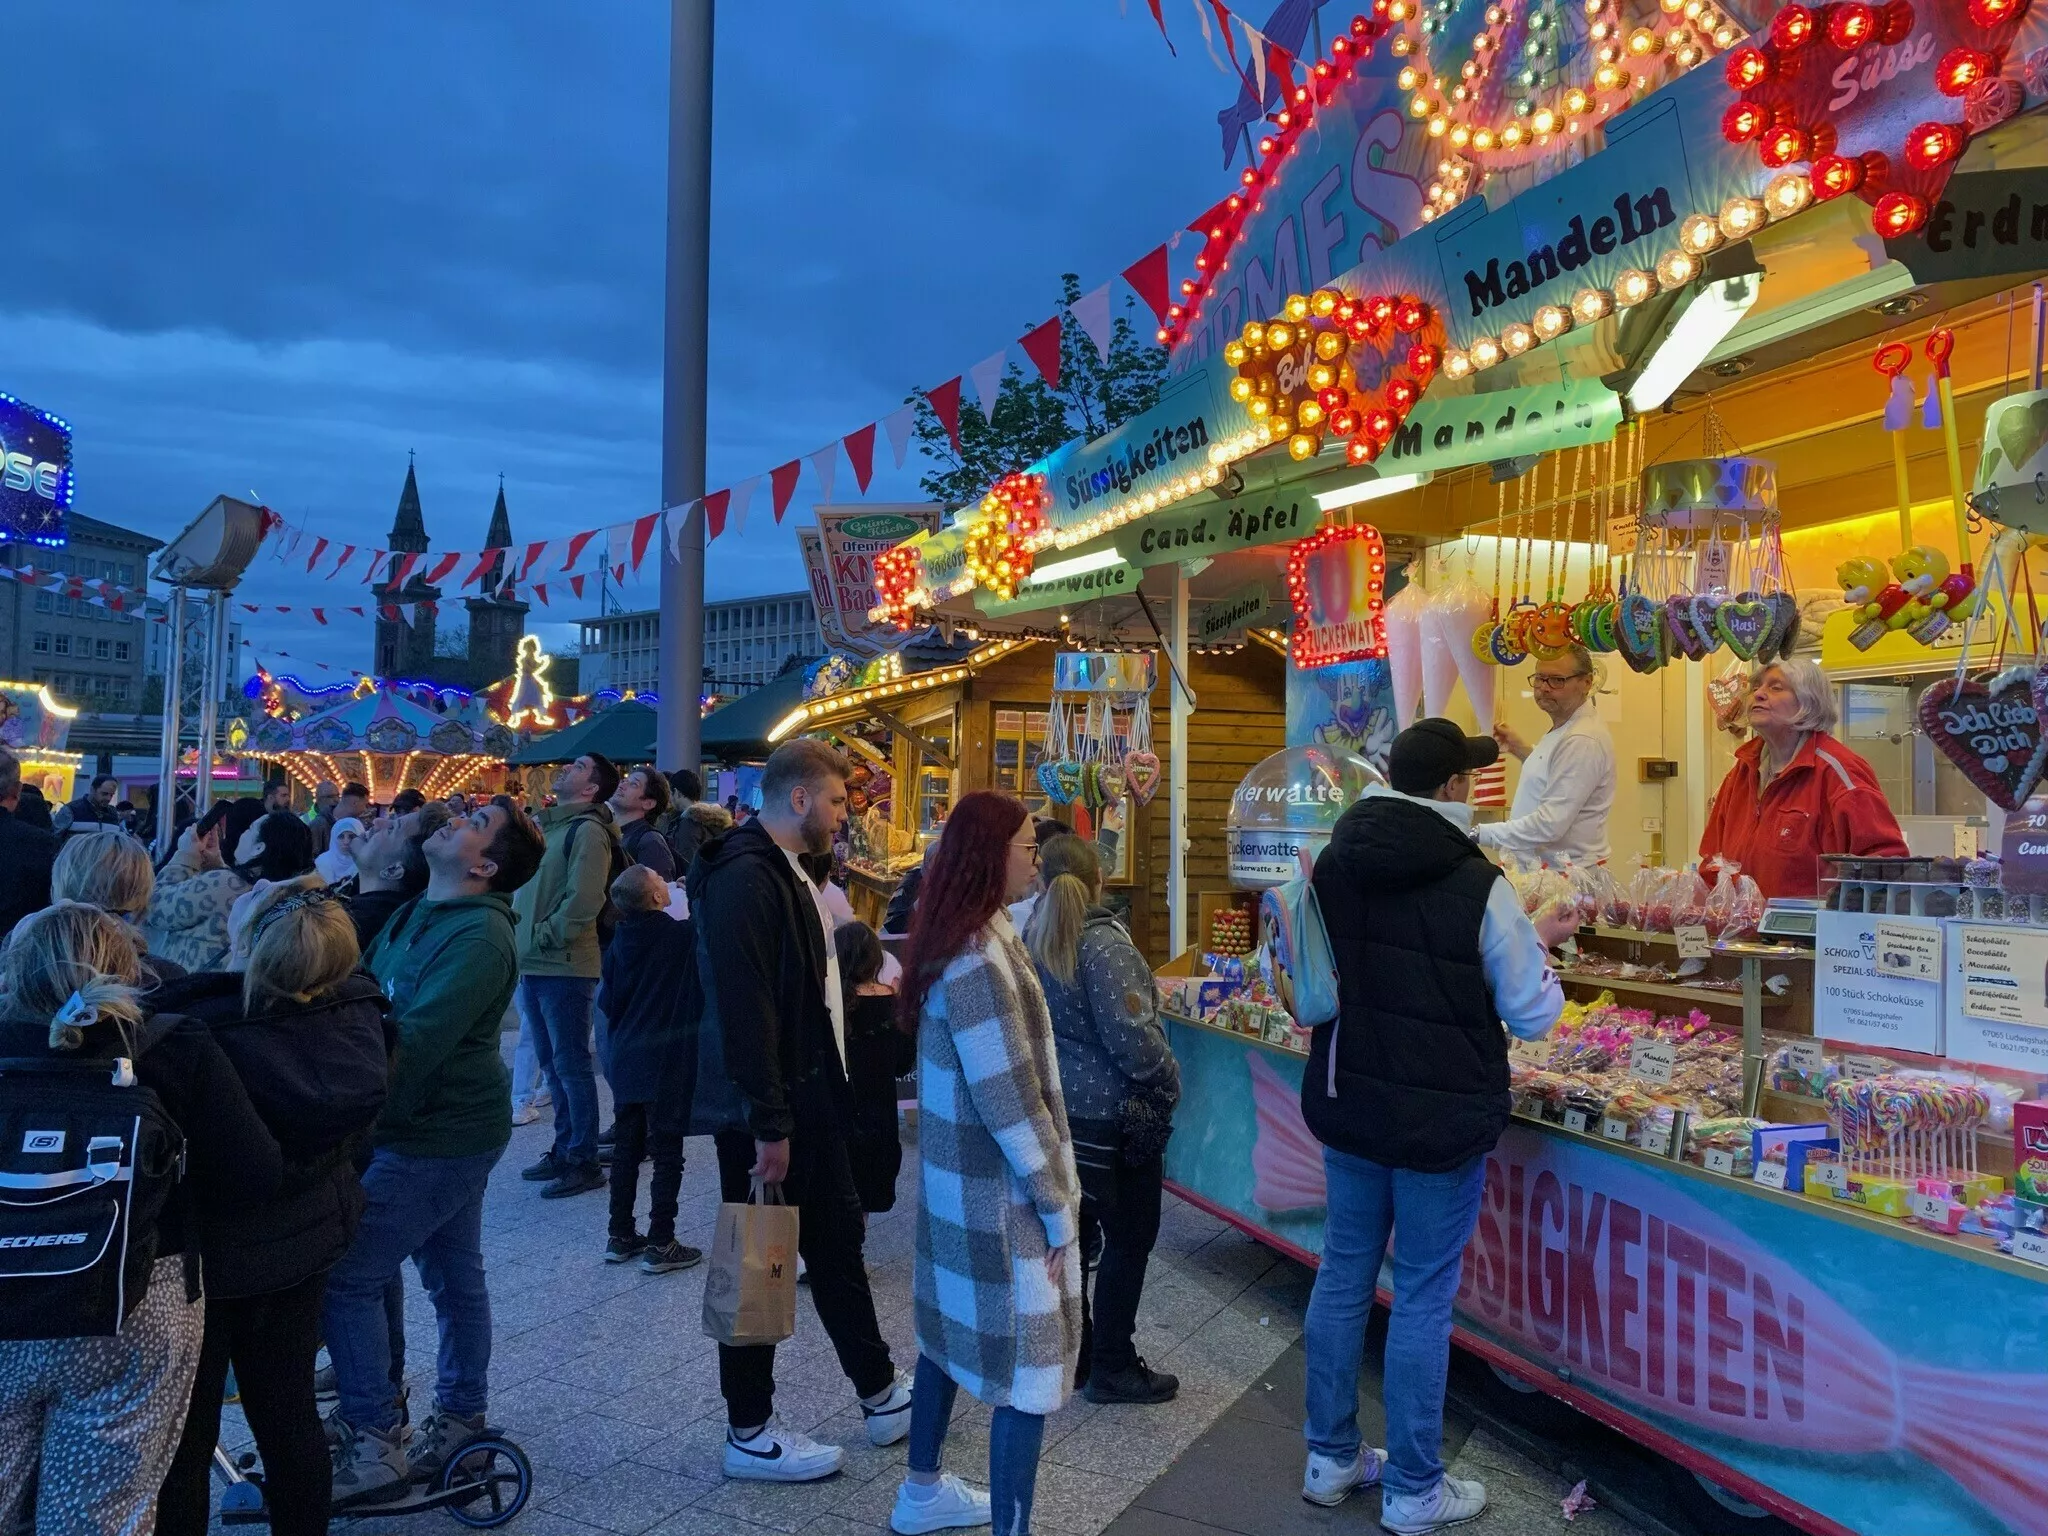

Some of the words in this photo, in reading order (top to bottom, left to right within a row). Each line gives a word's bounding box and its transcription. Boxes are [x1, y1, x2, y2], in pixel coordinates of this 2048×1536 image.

[1829, 31, 1937, 111] Süsse
[1464, 186, 1677, 317] Mandeln
[1392, 400, 1593, 459] Mandeln
[1066, 416, 1209, 510] Süssigkeiten
[850, 518, 892, 533] Grüne
[867, 523, 912, 538] Küche
[1140, 519, 1216, 554] Cand.
[1227, 503, 1298, 541] Äpfel
[1205, 598, 1260, 635] Süssigkeiten
[1970, 726, 2033, 755] Dich
[1966, 935, 2011, 946] Schokobälle
[1824, 947, 1860, 959] SCHOKO
[1966, 948, 2007, 958] Cocosbälle
[1968, 961, 2011, 972] Moccabälle
[1825, 986, 1840, 997] 100
[1842, 988, 1865, 1000] Stück
[1867, 991, 1924, 1008] Schokoküsse
[1970, 1002, 1996, 1012] Erdbeer
[1861, 1010, 1903, 1021] Ludwigshafen
[1881, 1022, 1890, 1030] 40
[1982, 1029, 2004, 1039] 67065
[1987, 1040, 1999, 1049] Tel.
[2000, 1043, 2029, 1053] 0621/57
[2030, 1048, 2040, 1056] 40
[1642, 1052, 1670, 1065] Mandeln
